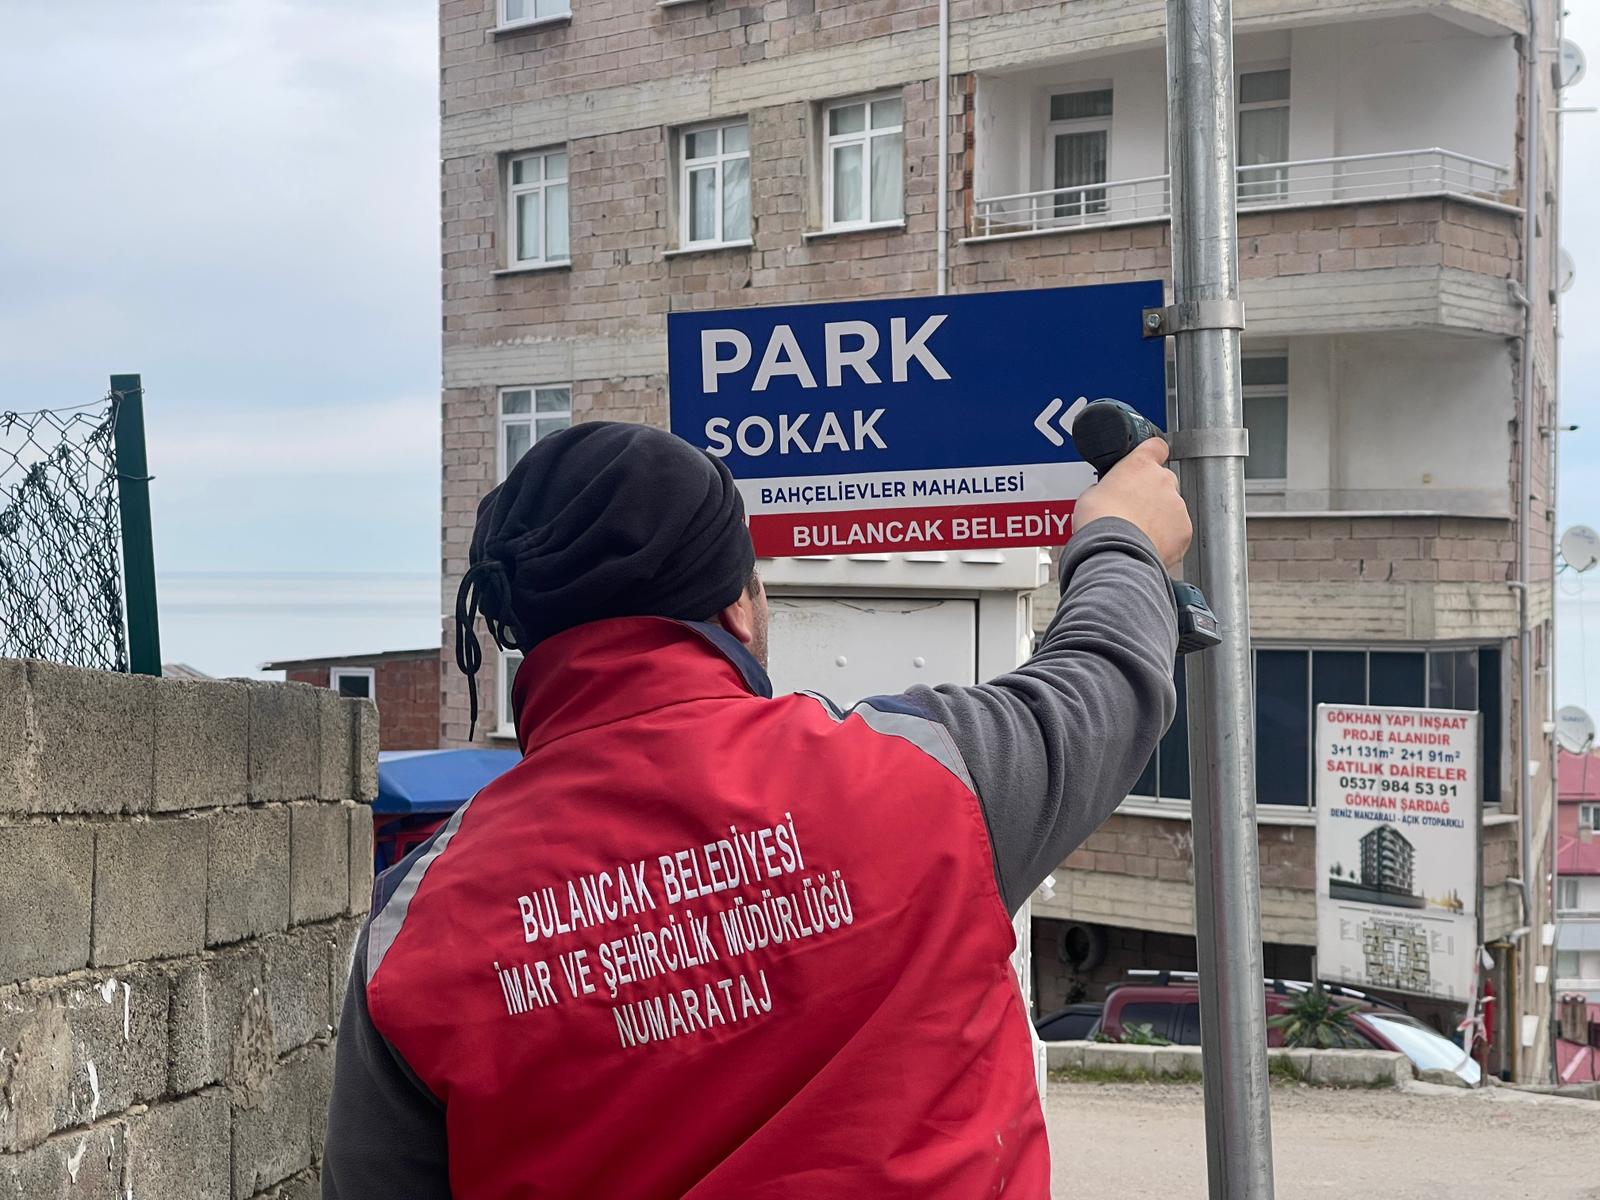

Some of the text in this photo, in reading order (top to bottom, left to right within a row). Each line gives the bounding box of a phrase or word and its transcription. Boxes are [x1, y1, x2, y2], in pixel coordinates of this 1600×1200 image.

[701, 314, 952, 394] PARK
[704, 408, 888, 458] SOKAK
[760, 471, 1025, 505] BAHÇELİEVLER MAHALLESİ
[793, 509, 1074, 547] BULANCAK BELEDİY
[1328, 711, 1468, 731] GÖKHAN YAPI İNŞAAT
[1343, 729, 1450, 745] PROJE ALANIDIR
[1331, 744, 1352, 756] 3+1
[1401, 749, 1423, 761] 2+1
[1327, 760, 1467, 781] SATILIK DAİRELER
[1340, 776, 1457, 797] 0537 984 53 91
[1330, 808, 1352, 818] DENİZ
[1402, 816, 1420, 826] AÇIK
[1345, 793, 1450, 814] GÖKHAN ŞARDAĞ
[517, 811, 805, 943] BULANCAK BELEDİYESİ
[493, 869, 854, 1016] İMAR VE ŞEHİRCİLİK MÜDÜRLÜĞÜ
[611, 969, 773, 1049] NUMARATAJ
